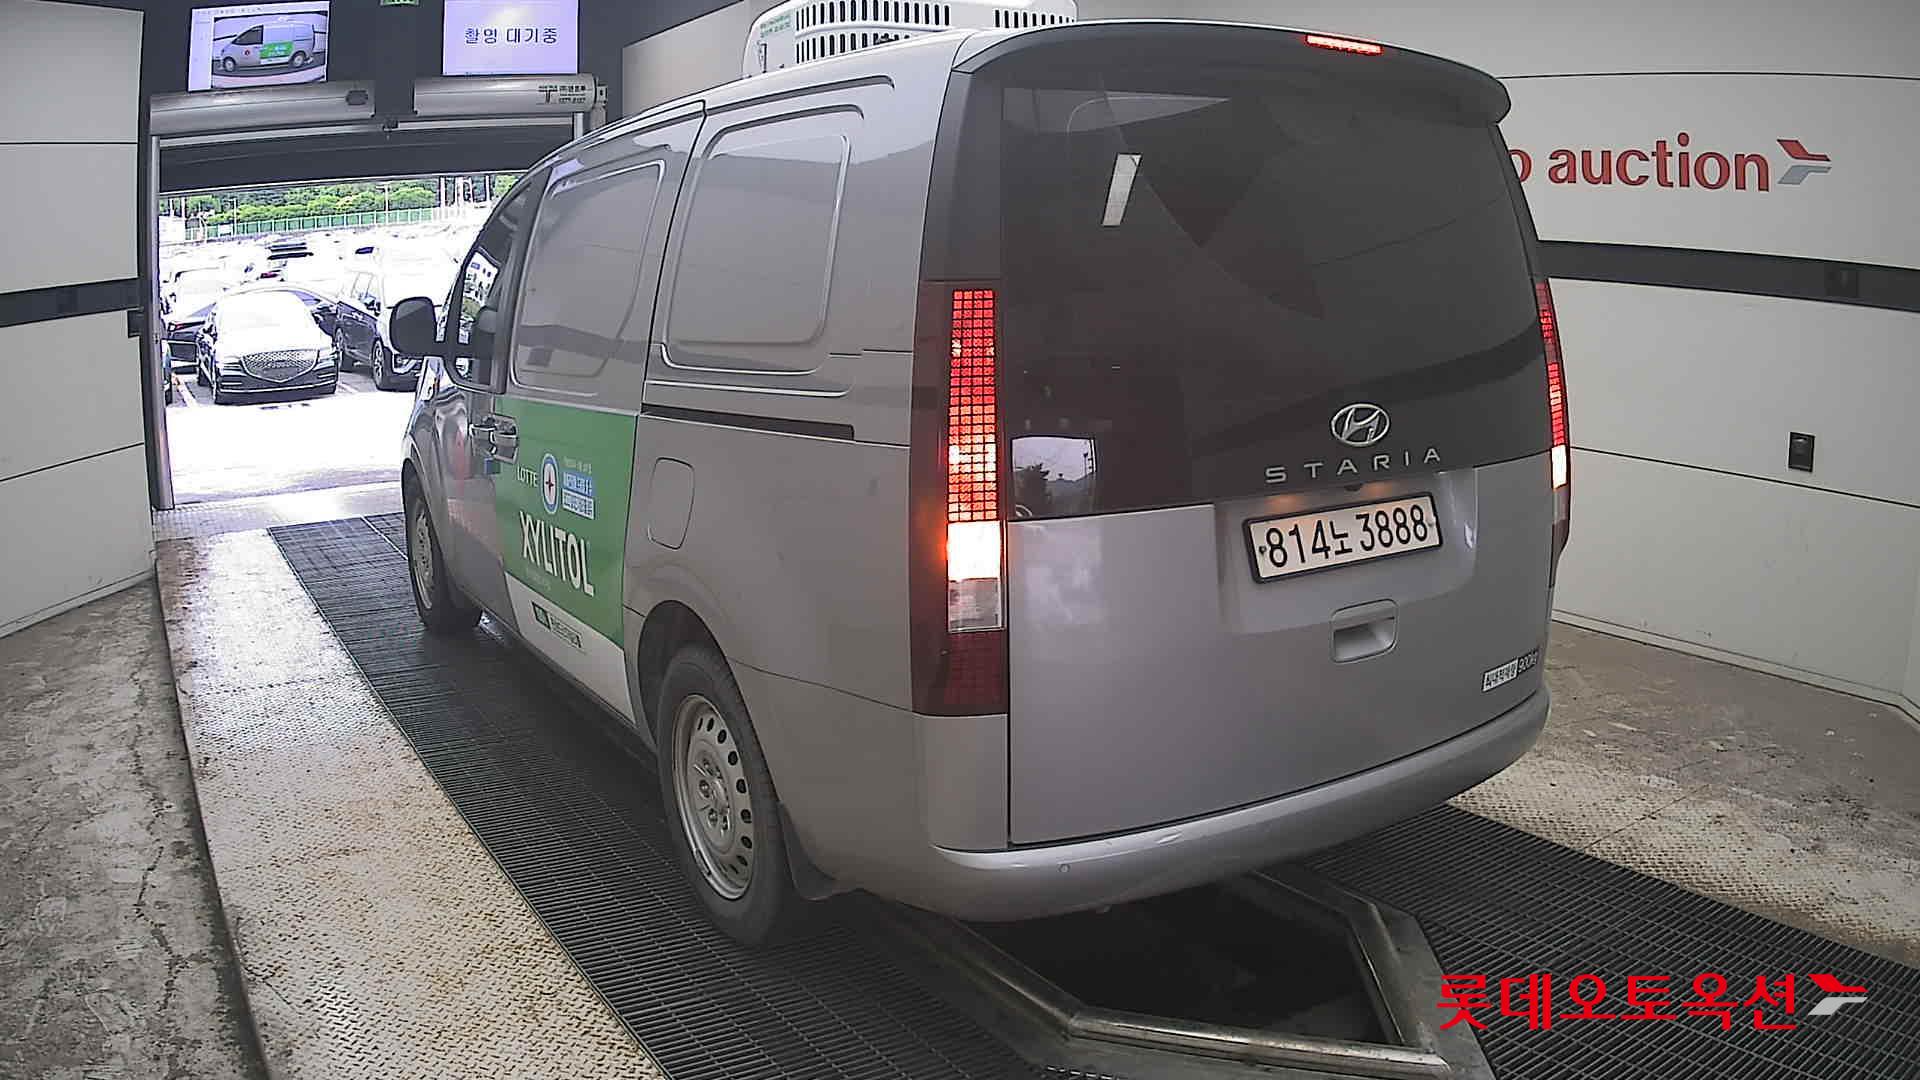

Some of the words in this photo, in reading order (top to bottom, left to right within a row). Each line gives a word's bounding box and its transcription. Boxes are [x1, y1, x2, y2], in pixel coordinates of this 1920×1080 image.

[465, 28, 497, 44] 촬영
[506, 28, 557, 44] 대기중
[1548, 132, 1770, 192] auction
[517, 466, 539, 487] LOTTE
[1265, 448, 1441, 484] STARIA
[519, 510, 595, 598] XYLITOL
